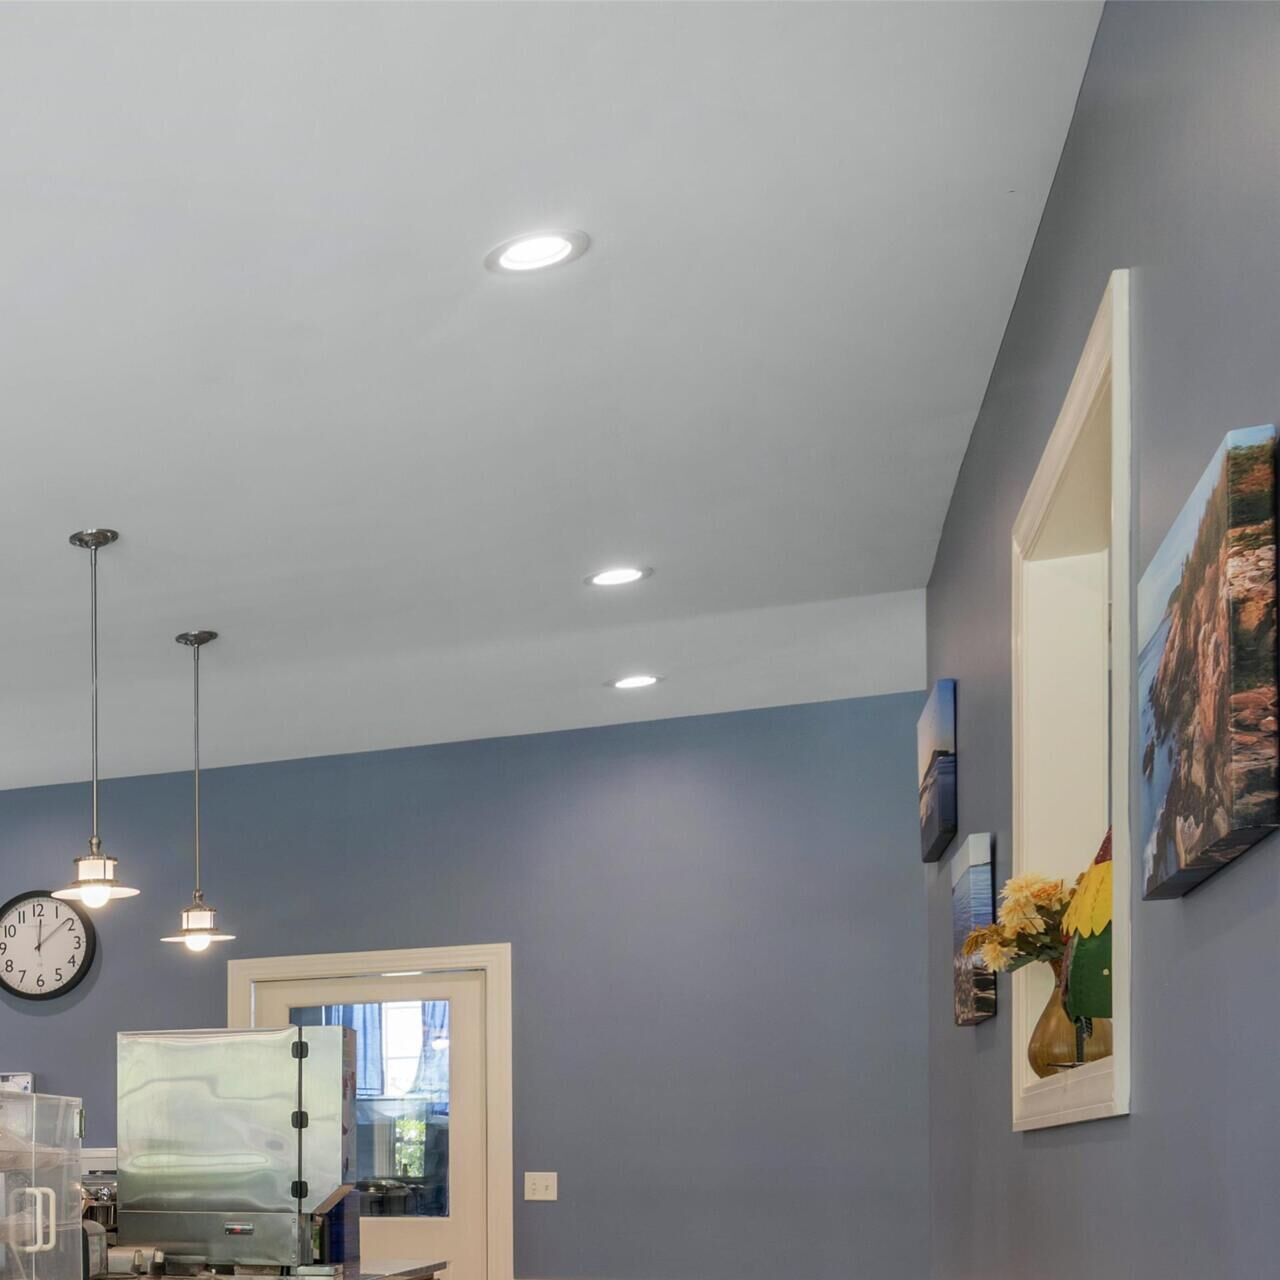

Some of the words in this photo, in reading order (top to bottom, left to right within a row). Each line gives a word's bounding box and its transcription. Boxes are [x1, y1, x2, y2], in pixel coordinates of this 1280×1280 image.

[18, 910, 26, 924] 11
[33, 903, 45, 917] 12
[55, 905, 59, 919] 1
[4, 924, 17, 938] 10
[66, 917, 76, 931] 2
[73, 936, 81, 950] 3
[5, 959, 14, 973] 8
[67, 955, 76, 967] 4
[18, 970, 26, 983] 7
[36, 974, 45, 987] 6
[55, 968, 62, 982] 5
